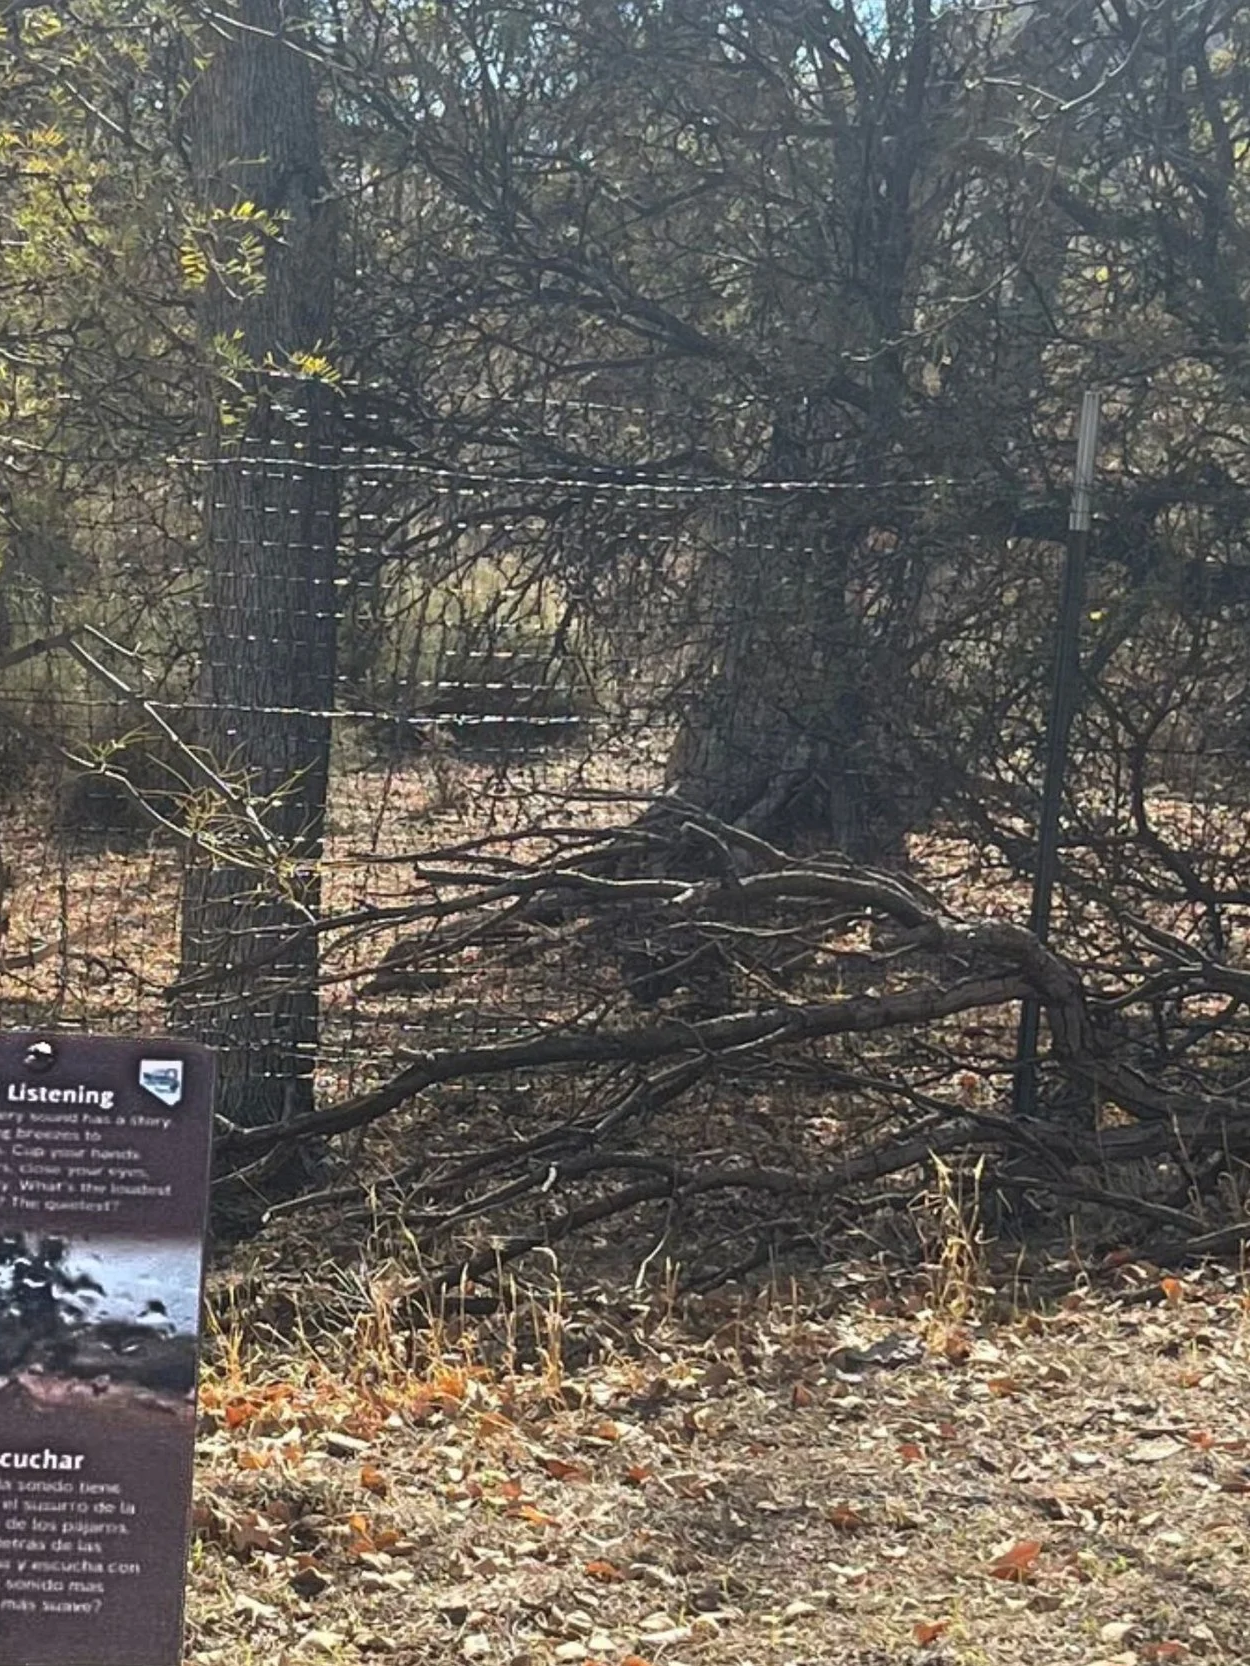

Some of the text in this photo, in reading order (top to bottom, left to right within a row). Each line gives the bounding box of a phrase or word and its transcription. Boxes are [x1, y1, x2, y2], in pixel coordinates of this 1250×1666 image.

[7, 1082, 115, 1110] Listening
[82, 1112, 111, 1125] has
[115, 1115, 126, 1126] a
[93, 1501, 117, 1514] de
[120, 1501, 136, 1515] la
[5, 1516, 27, 1530] de
[31, 1517, 57, 1532] los
[51, 1538, 73, 1552] de
[77, 1539, 102, 1553] las
[17, 1559, 28, 1572] y
[107, 1562, 141, 1575] con
